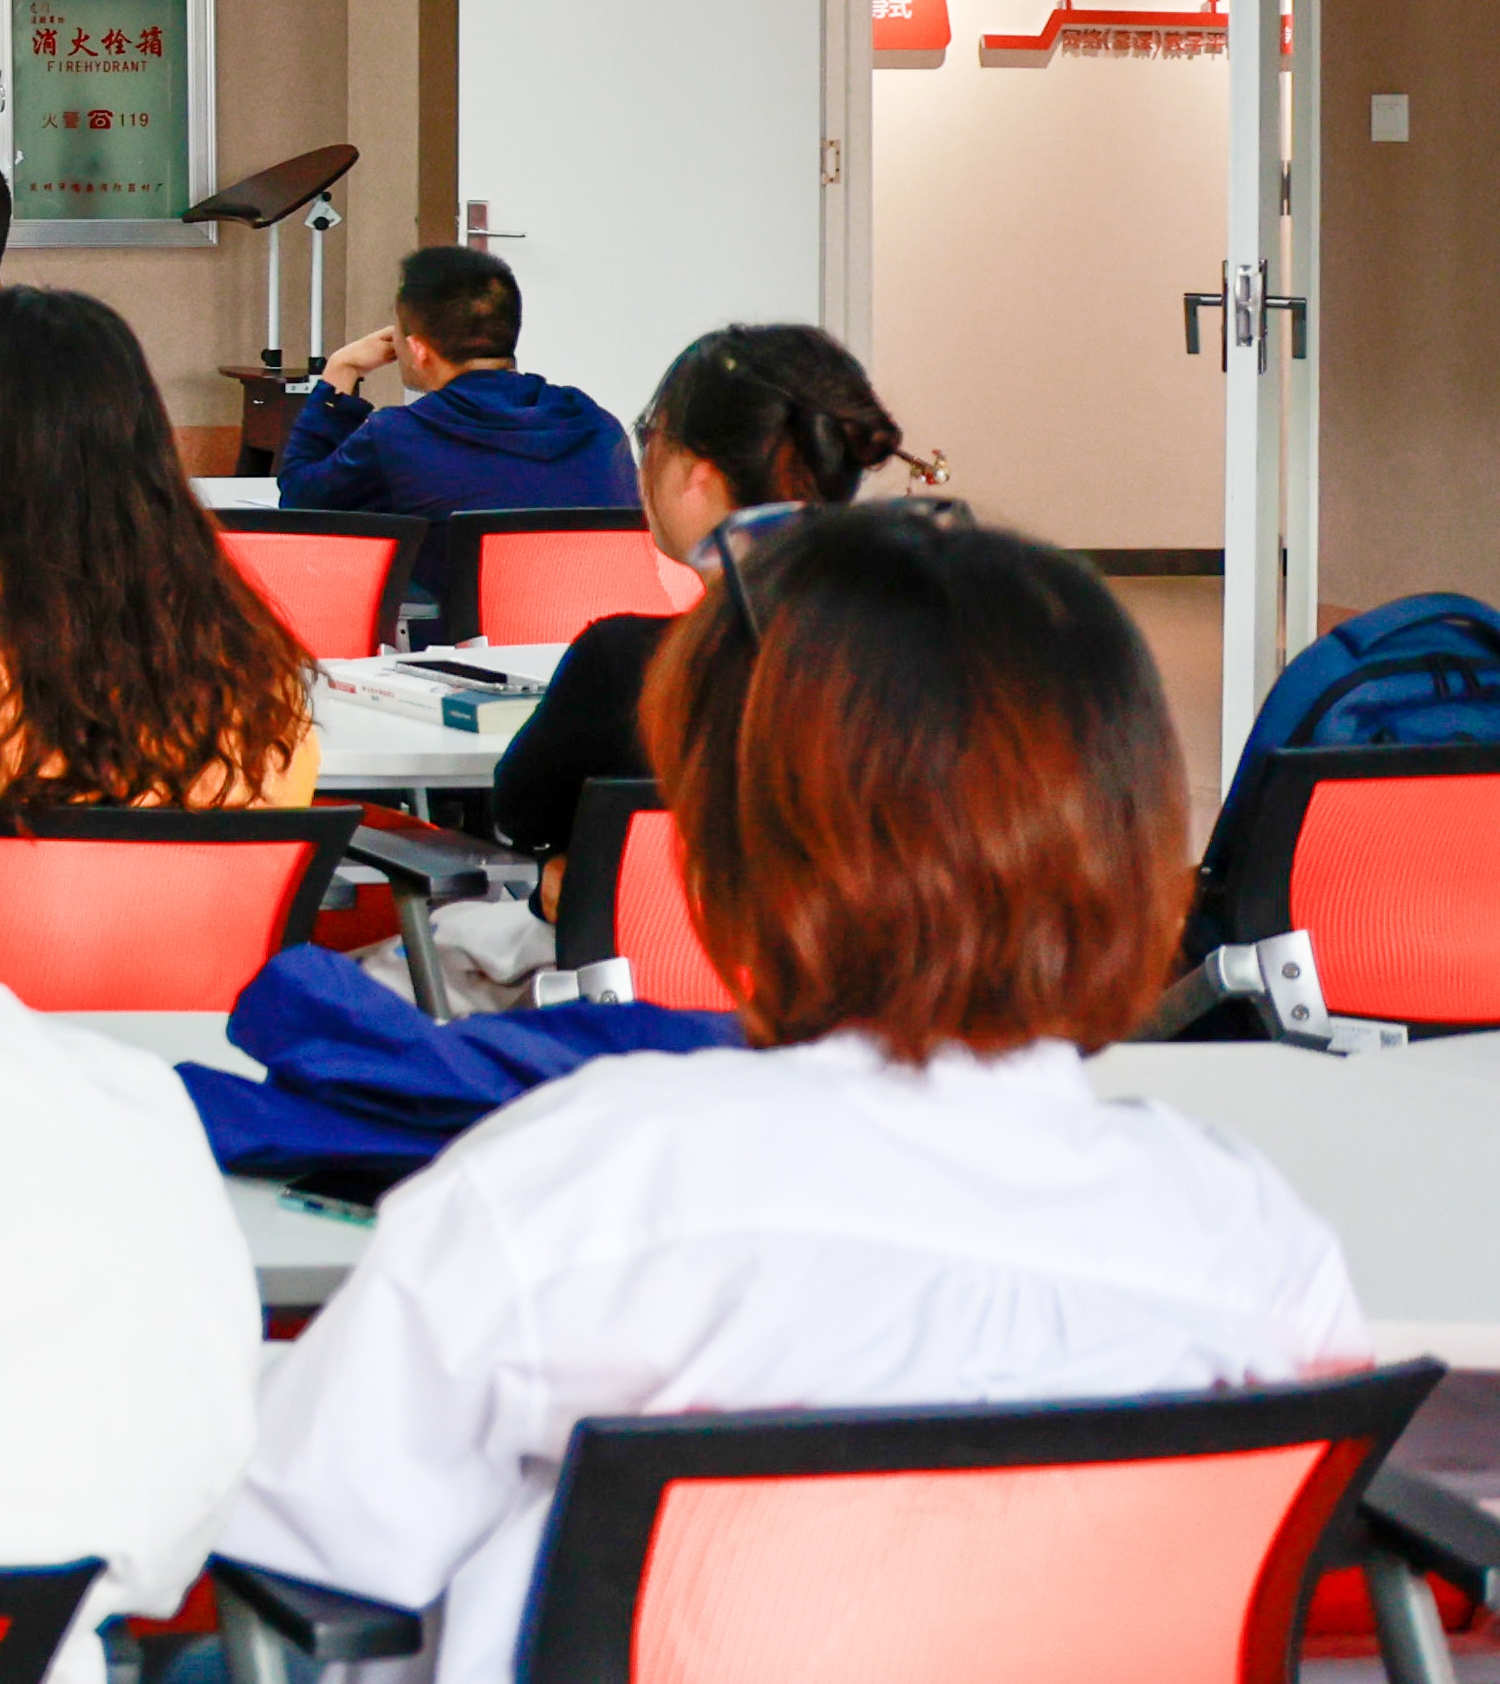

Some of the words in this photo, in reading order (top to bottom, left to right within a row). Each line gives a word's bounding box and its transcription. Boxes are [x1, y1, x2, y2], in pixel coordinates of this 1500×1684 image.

[32, 26, 163, 57] 消火栓箱
[47, 60, 148, 73] FIREHYDRANT
[42, 111, 80, 129] 火警
[119, 112, 149, 127] 119
